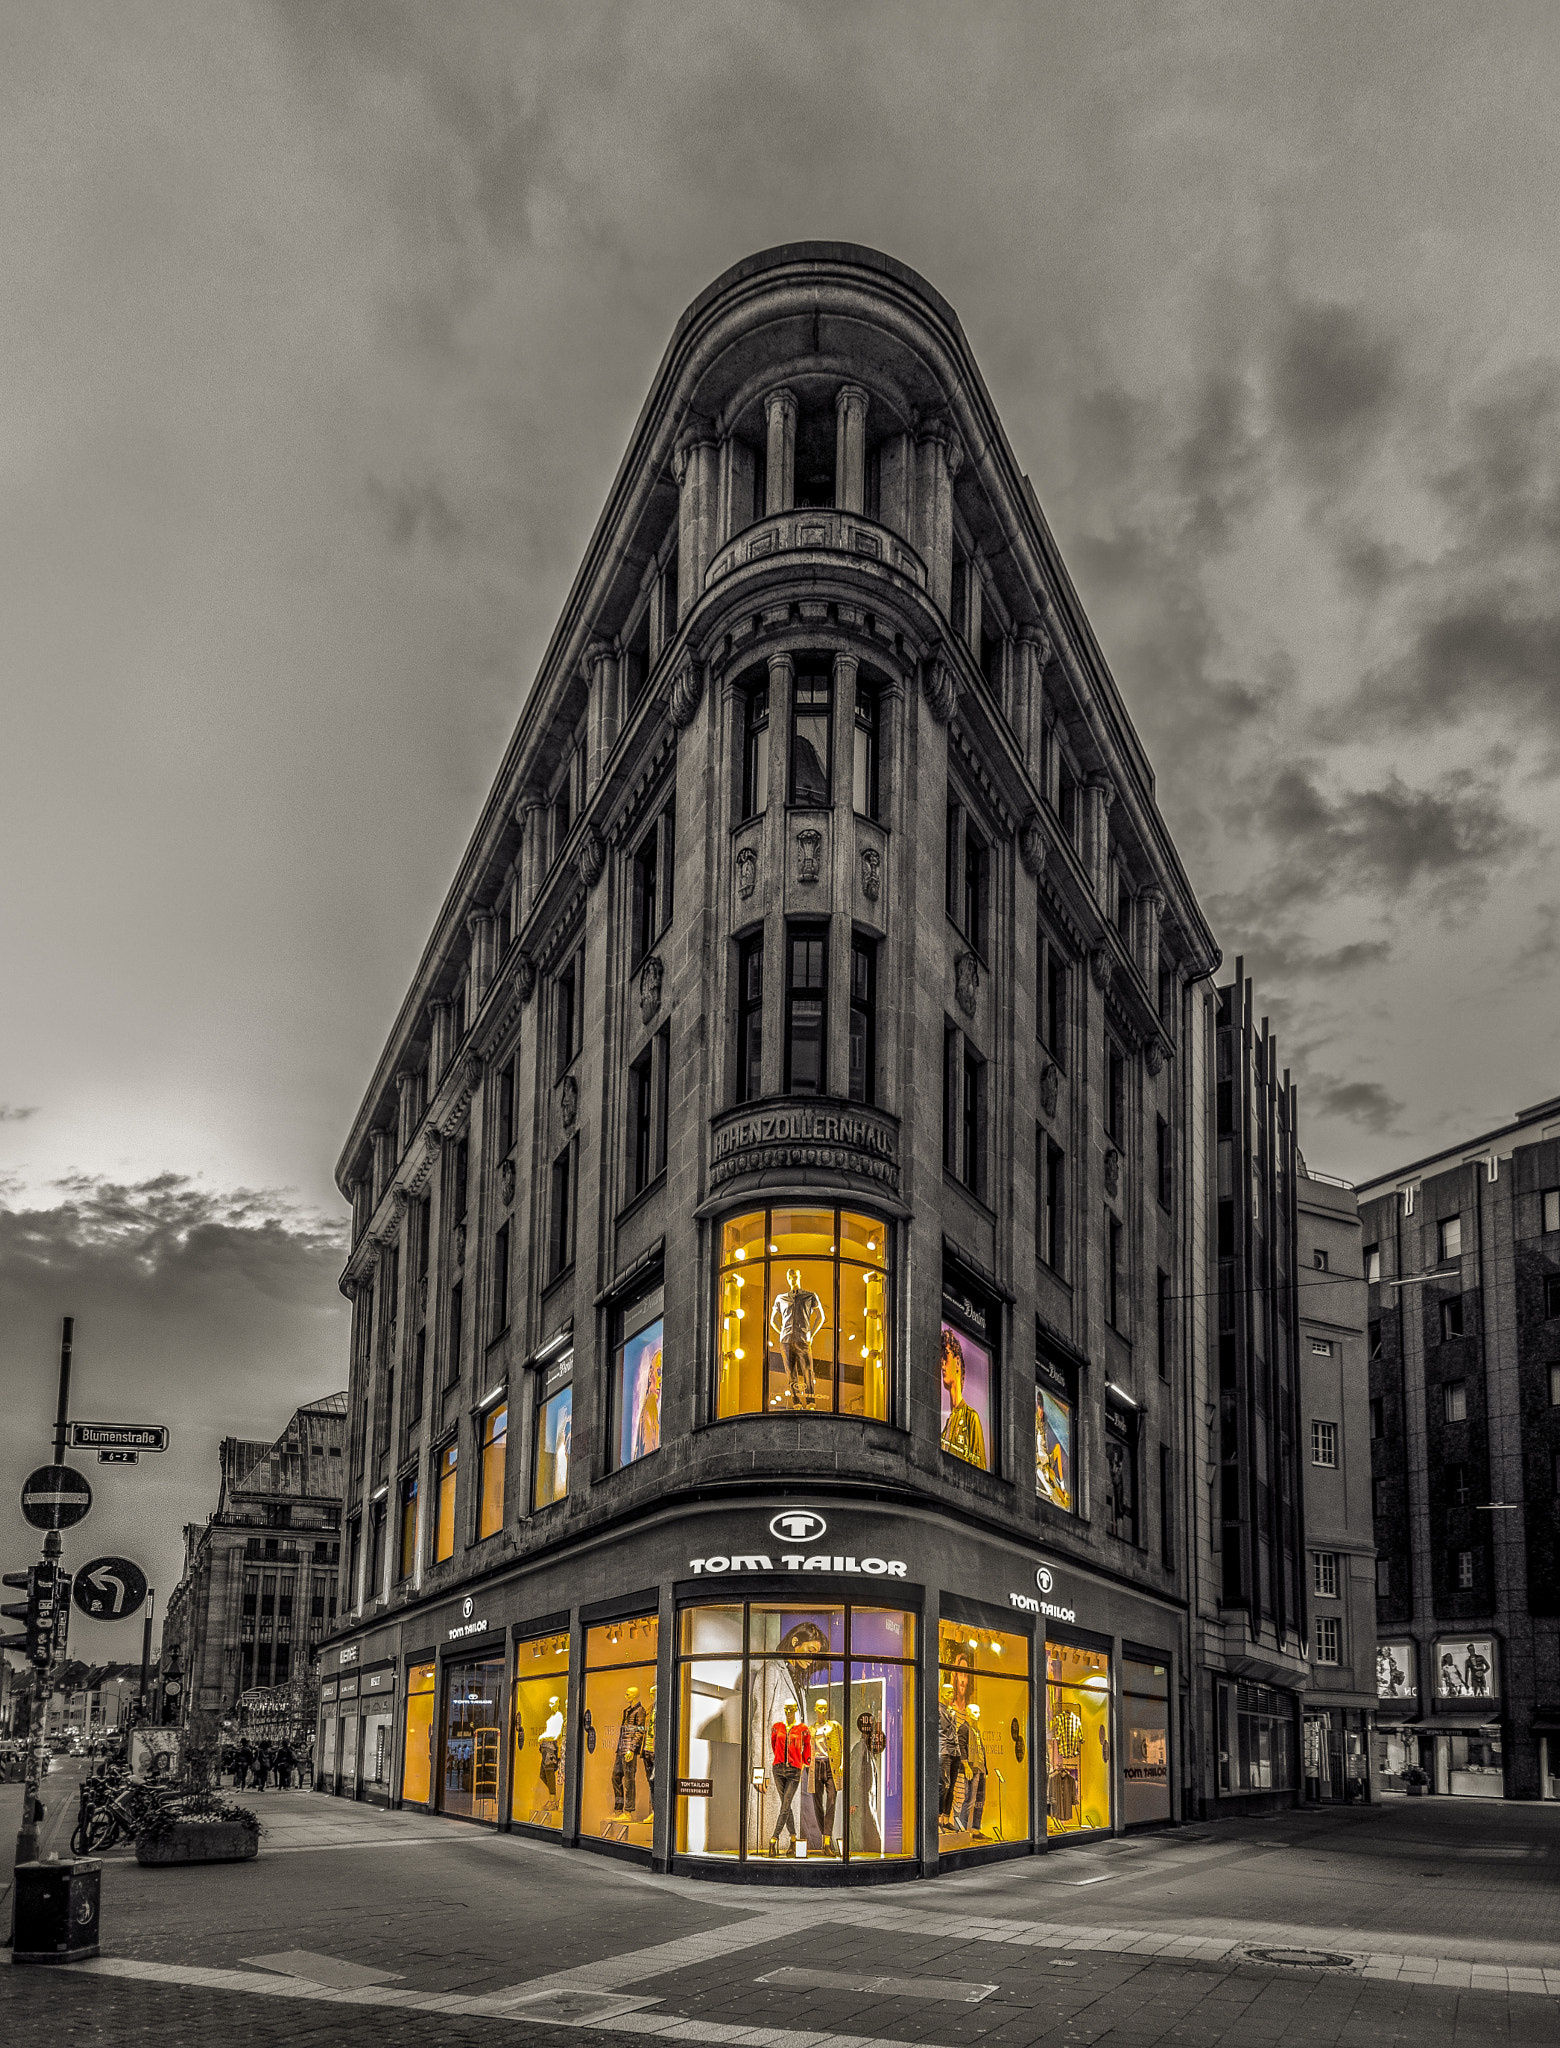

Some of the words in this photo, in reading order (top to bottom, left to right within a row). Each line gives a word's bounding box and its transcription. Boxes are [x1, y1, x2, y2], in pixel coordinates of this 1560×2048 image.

[715, 1114, 893, 1157] HOHENZOLLERNHAUS
[82, 1428, 155, 1444] Blumenstraße
[689, 1555, 773, 1574] TOM
[781, 1555, 908, 1577] TAILOR
[1009, 1593, 1039, 1612] TOM
[1040, 1602, 1075, 1623] TAILOR
[449, 1627, 464, 1639] TOM
[464, 1619, 488, 1635] TAILOR
[1124, 1768, 1143, 1778] TOM
[1144, 1767, 1167, 1777] TAILOR
